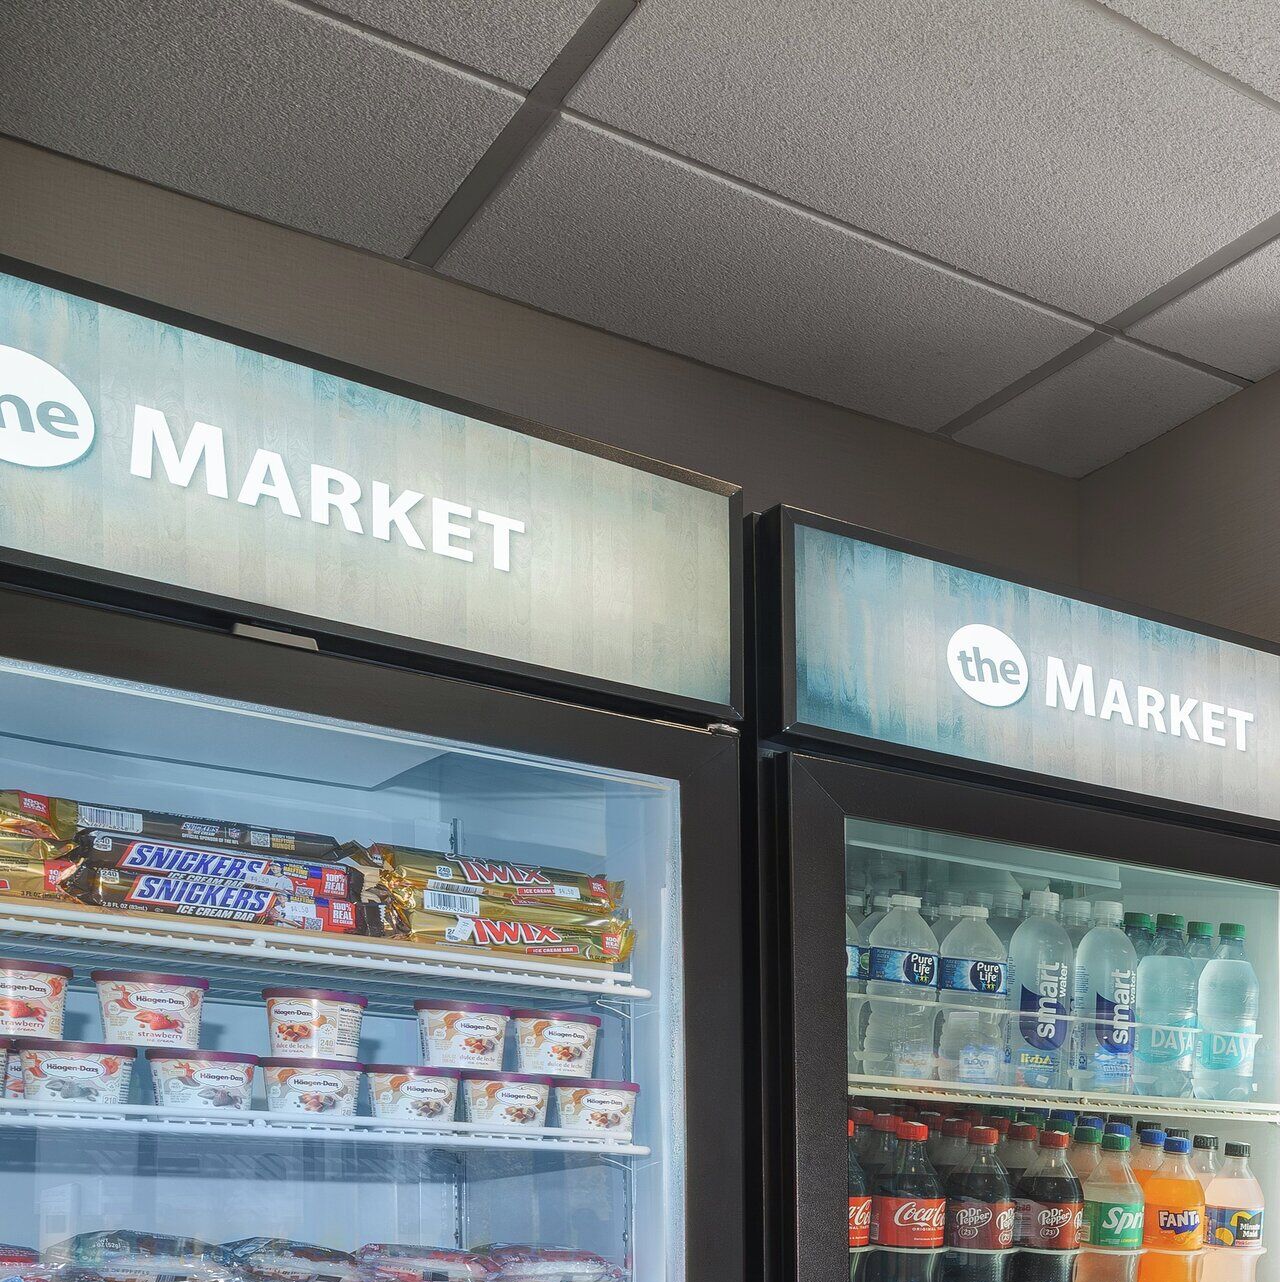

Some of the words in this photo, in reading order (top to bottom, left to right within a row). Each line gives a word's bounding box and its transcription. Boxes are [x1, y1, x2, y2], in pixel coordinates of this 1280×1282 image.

[129, 405, 527, 574] MARKET
[957, 647, 1021, 685] the
[1045, 655, 1255, 752] MARKET
[129, 844, 263, 878] SNICKERS
[325, 875, 346, 884] 100%
[139, 876, 274, 911] SNICKERS
[324, 884, 345, 894] REAL
[176, 904, 193, 914] ICE
[195, 906, 232, 919] CREAM
[234, 911, 255, 922] BAR
[332, 902, 353, 912] 100%
[332, 911, 353, 921] REAL
[470, 917, 562, 945] TWIX
[911, 954, 933, 966] Pure
[913, 962, 930, 975] Life
[976, 962, 999, 973] Pure
[979, 972, 996, 984] Life
[1060, 963, 1068, 998] water
[1037, 961, 1060, 1039] smart
[1113, 969, 1130, 1045] smart
[138, 1031, 182, 1040] strawberry
[1159, 1210, 1200, 1227] FANTA
